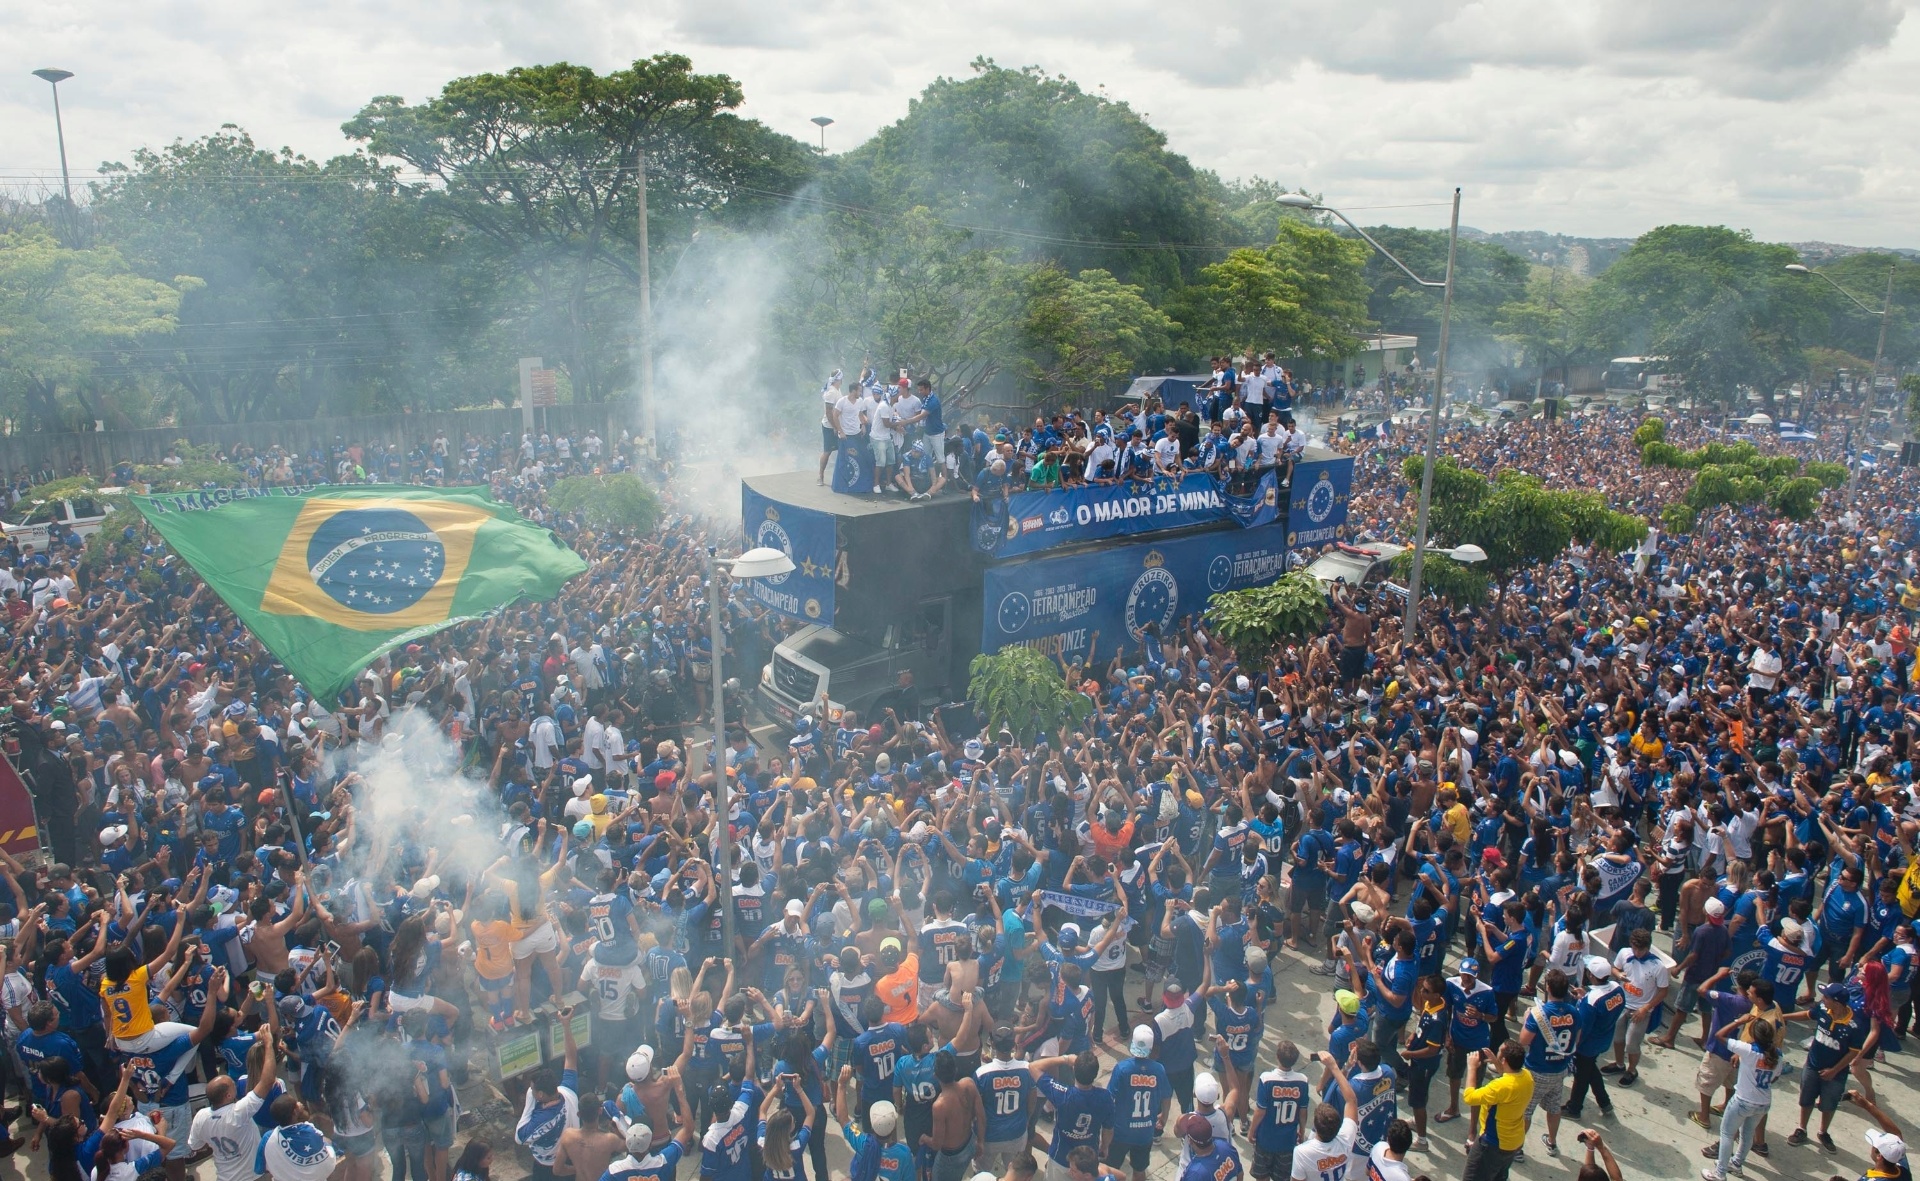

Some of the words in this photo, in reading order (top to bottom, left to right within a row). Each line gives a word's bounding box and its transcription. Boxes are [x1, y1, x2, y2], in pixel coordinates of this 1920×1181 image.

[1076, 504, 1092, 525] O
[1094, 497, 1151, 523] MAIOR
[1156, 494, 1177, 515] DE
[1179, 489, 1226, 512] MINA
[760, 522, 788, 546] CRUZEIRO
[1297, 525, 1336, 545] TETRACAMPEÃO
[316, 548, 343, 573] ORDEM
[347, 539, 359, 549] E
[1233, 553, 1283, 578] TETRACAMPEÃO
[1133, 570, 1174, 597] CRUZEIRO
[753, 579, 799, 614] TETRACAMPEÃO
[1032, 586, 1097, 617] TETRACAMPEÃO
[526, 692, 535, 708] 7
[1563, 785, 1577, 798] 10
[632, 832, 645, 842] BM
[594, 916, 615, 942] 10
[933, 931, 957, 944] BMG
[650, 952, 669, 981] 10
[1738, 951, 1768, 966] CRUZE
[1775, 964, 1801, 985] 10
[190, 989, 208, 1008] 10
[599, 980, 620, 1001] 15
[114, 998, 133, 1023] 9
[1605, 993, 1624, 1011] BMG
[1549, 1014, 1574, 1027] BMG
[22, 1045, 45, 1058] TENDA
[869, 1038, 896, 1056] BMG
[873, 1052, 895, 1080] 10
[992, 1075, 1021, 1090] BMG
[1130, 1074, 1157, 1088] BMG
[1755, 1069, 1773, 1090] 10
[911, 1081, 937, 1102] 10
[1272, 1086, 1300, 1099] BMG
[995, 1090, 1020, 1115] 10
[1132, 1090, 1152, 1118] 11
[1273, 1100, 1298, 1125] 10
[1358, 1090, 1396, 1117] CRUZEI
[1075, 1113, 1092, 1136] 9
[210, 1135, 241, 1157] 10
[724, 1124, 745, 1147] BMG
[281, 1138, 333, 1168] RUZEIRO
[1317, 1153, 1348, 1172] BMG
[880, 1158, 899, 1171] MG
[1214, 1156, 1235, 1181] BMG
